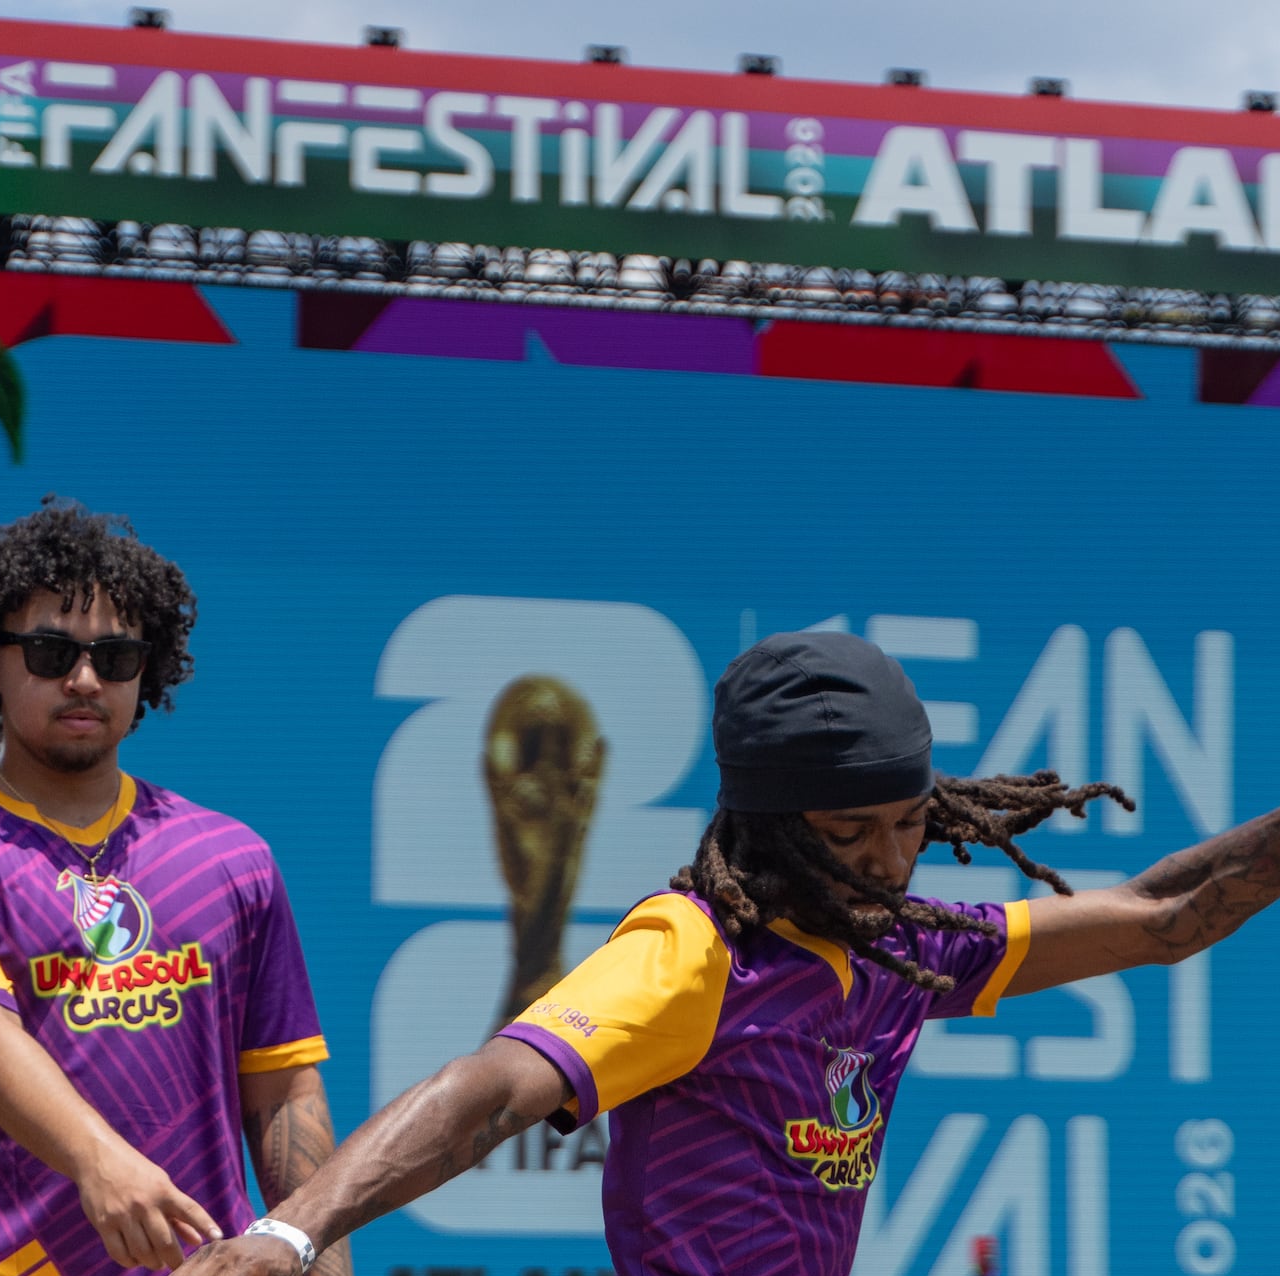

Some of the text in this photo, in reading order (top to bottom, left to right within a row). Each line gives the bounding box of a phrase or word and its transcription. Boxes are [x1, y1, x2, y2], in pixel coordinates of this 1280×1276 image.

[35, 946, 210, 993] UNIVERSOUL
[70, 987, 179, 1026] CIRCUS
[558, 1007, 598, 1038] 1994
